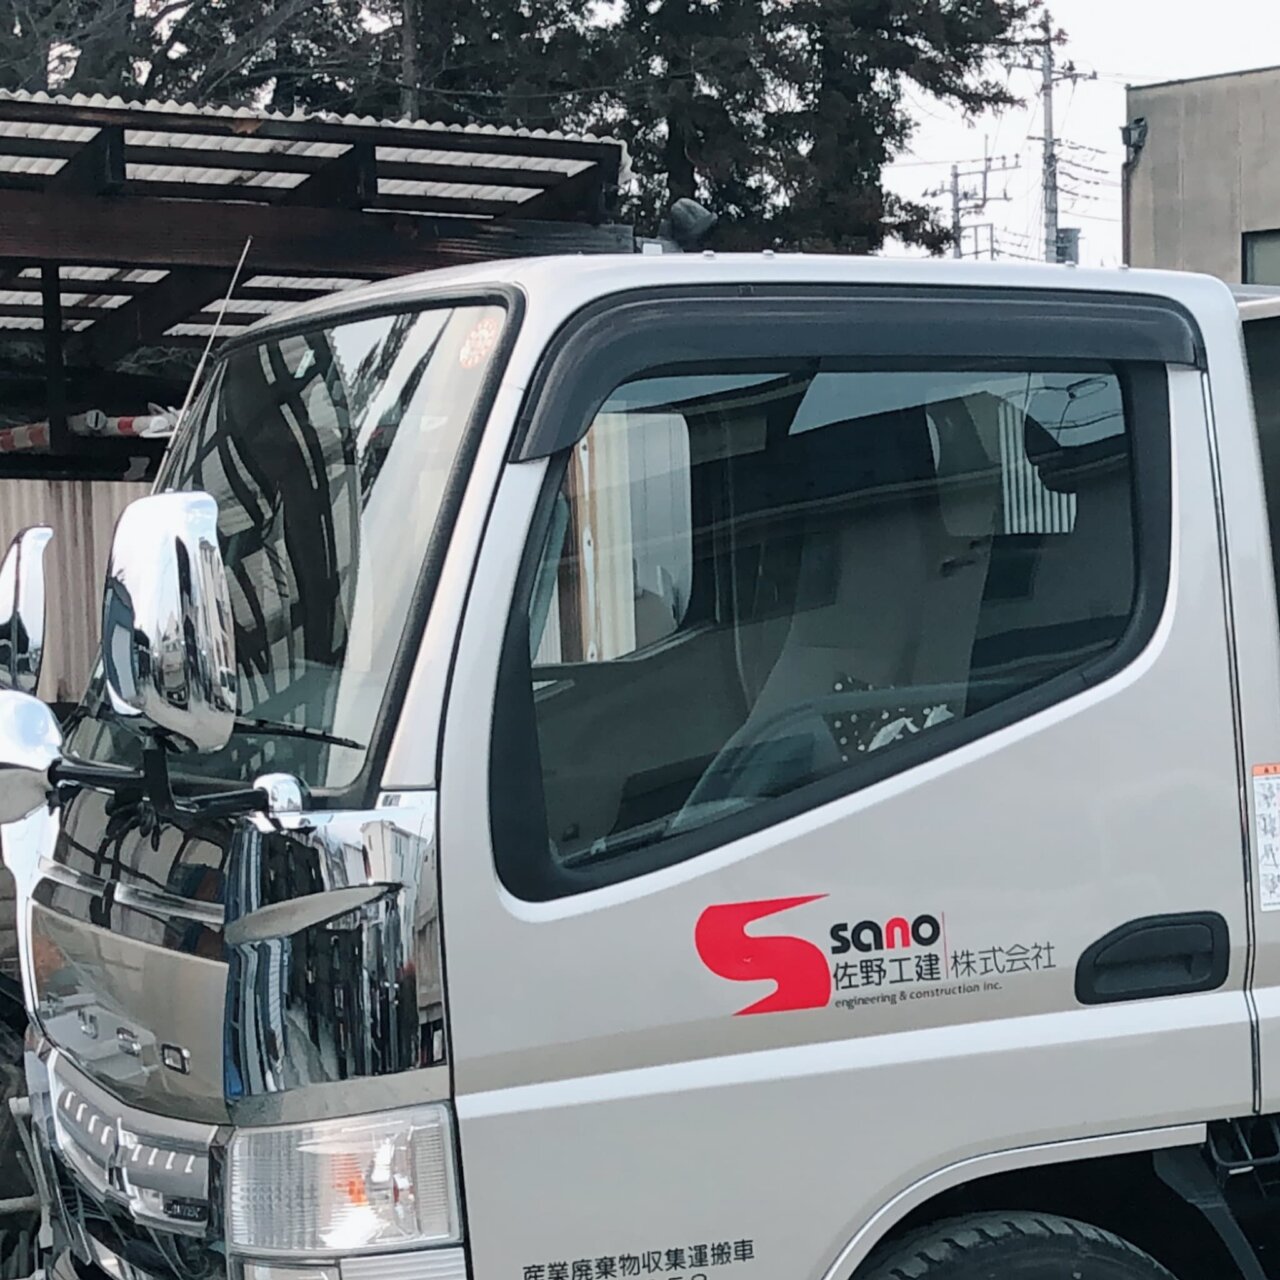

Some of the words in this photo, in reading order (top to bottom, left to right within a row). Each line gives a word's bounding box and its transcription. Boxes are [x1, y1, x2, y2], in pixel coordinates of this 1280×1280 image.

[829, 913, 941, 955] sano
[832, 953, 941, 991] 佐野工建
[950, 941, 1057, 978] 株式会社
[834, 992, 898, 1010] engineering
[899, 990, 907, 1001] &
[908, 984, 980, 1001] construction
